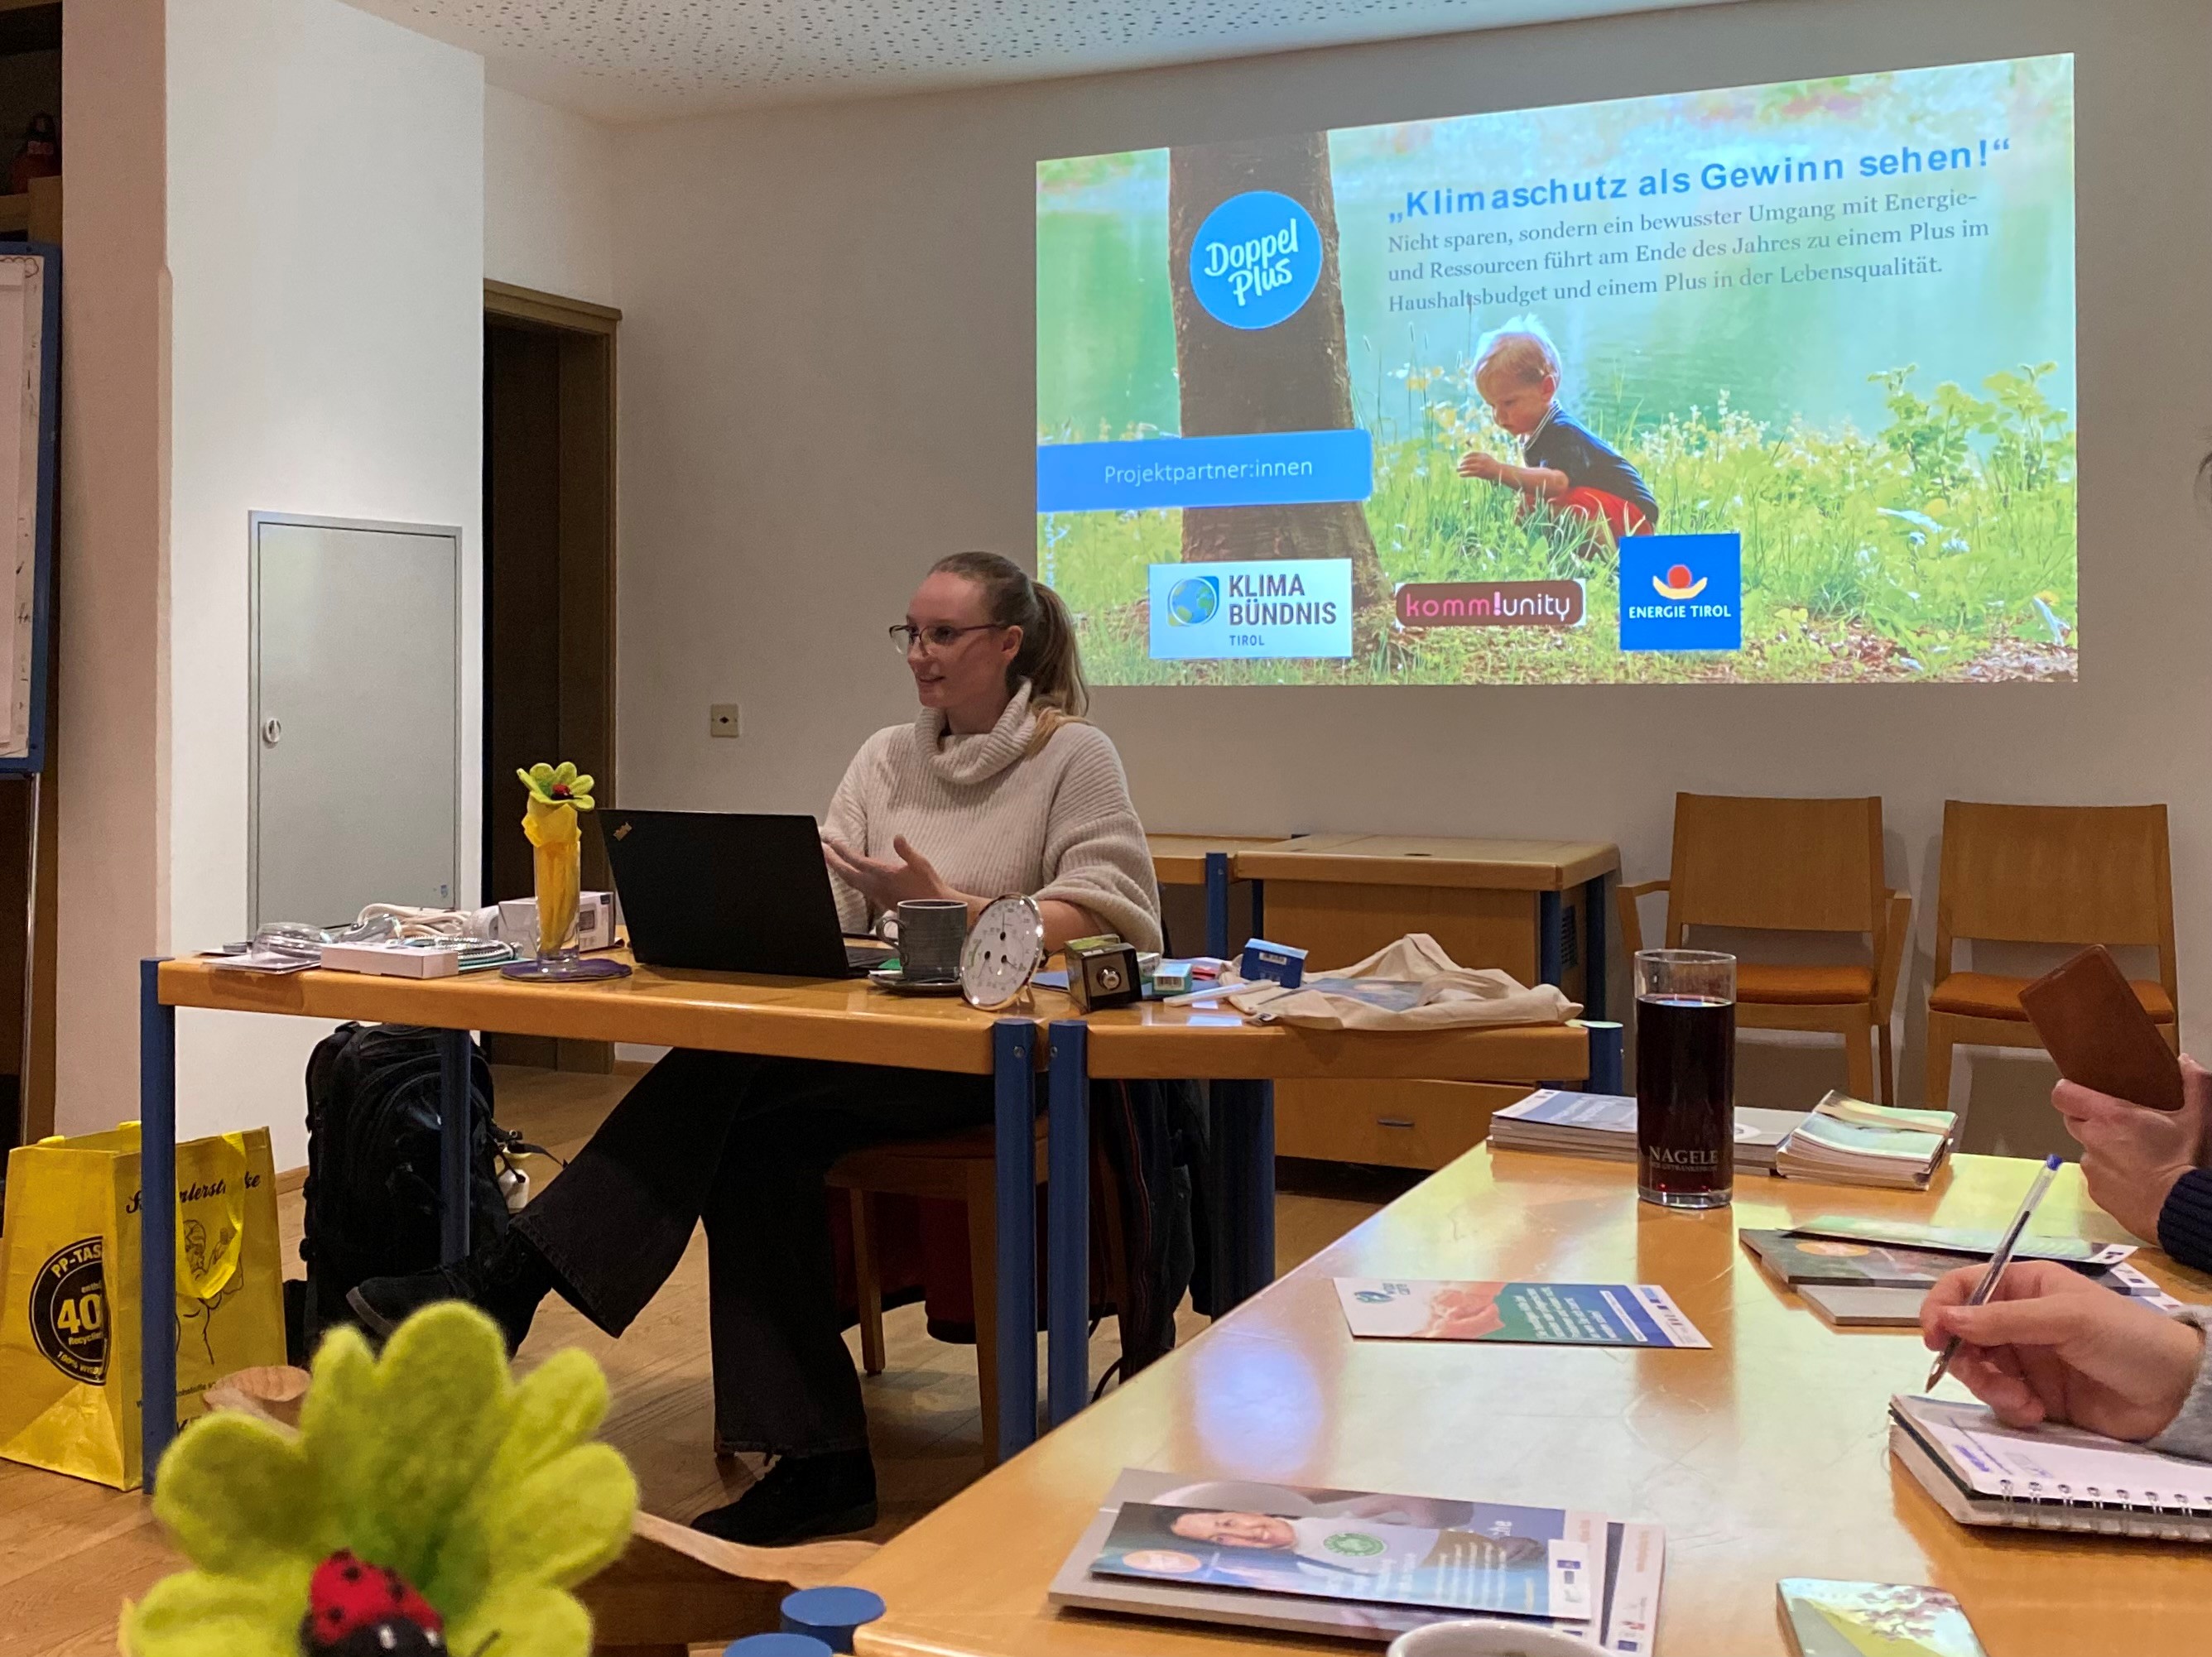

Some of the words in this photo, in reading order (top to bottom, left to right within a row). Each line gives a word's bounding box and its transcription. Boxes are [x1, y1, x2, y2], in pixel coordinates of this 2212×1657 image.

[1388, 175, 1628, 223] „Klimaschutz
[1638, 168, 1690, 197] als
[1700, 156, 1844, 191] Gewinn
[1859, 137, 2011, 177] sehen!“
[1388, 232, 1440, 252] Nicht
[1444, 230, 1513, 252] sparen,
[1518, 221, 1598, 242] sondern
[1604, 217, 1634, 234] ein
[1640, 210, 1743, 232] bewusster
[1748, 202, 1836, 223] Umgang
[1842, 195, 1879, 215] mit
[1884, 189, 1979, 212] Energie-
[1204, 218, 1299, 276] Doppel
[1388, 262, 1424, 281] und
[1430, 257, 1538, 279] Ressourcen
[1544, 251, 1594, 270] führt
[1599, 251, 1629, 266] am
[1635, 242, 1687, 263] Ende
[1692, 238, 1728, 257] des
[1732, 235, 1801, 256] Jahres
[1807, 234, 1831, 249] zu
[1836, 228, 1902, 247] einem
[1909, 221, 1955, 242] Plus
[1961, 219, 1989, 238] im
[1228, 257, 1292, 306] Plus
[1388, 286, 1548, 313] Haushaltsbudget
[1554, 280, 1592, 300] und
[1597, 278, 1658, 297] einem
[1664, 272, 1708, 293] Plus
[1714, 270, 1734, 289] in
[1739, 267, 1774, 286] der
[1780, 256, 1943, 284] Lebensqualität.
[1104, 459, 1313, 487] Projektpartner:innen
[1229, 573, 1306, 598] KLIMA
[1229, 599, 1337, 627] BÜNDNIS
[1406, 590, 1570, 622] komm!unity
[1628, 605, 1686, 619] ENERGIE
[1690, 604, 1732, 618] TIROL
[1229, 635, 1265, 647] TIROL
[1649, 1145, 1719, 1165] NAGELE
